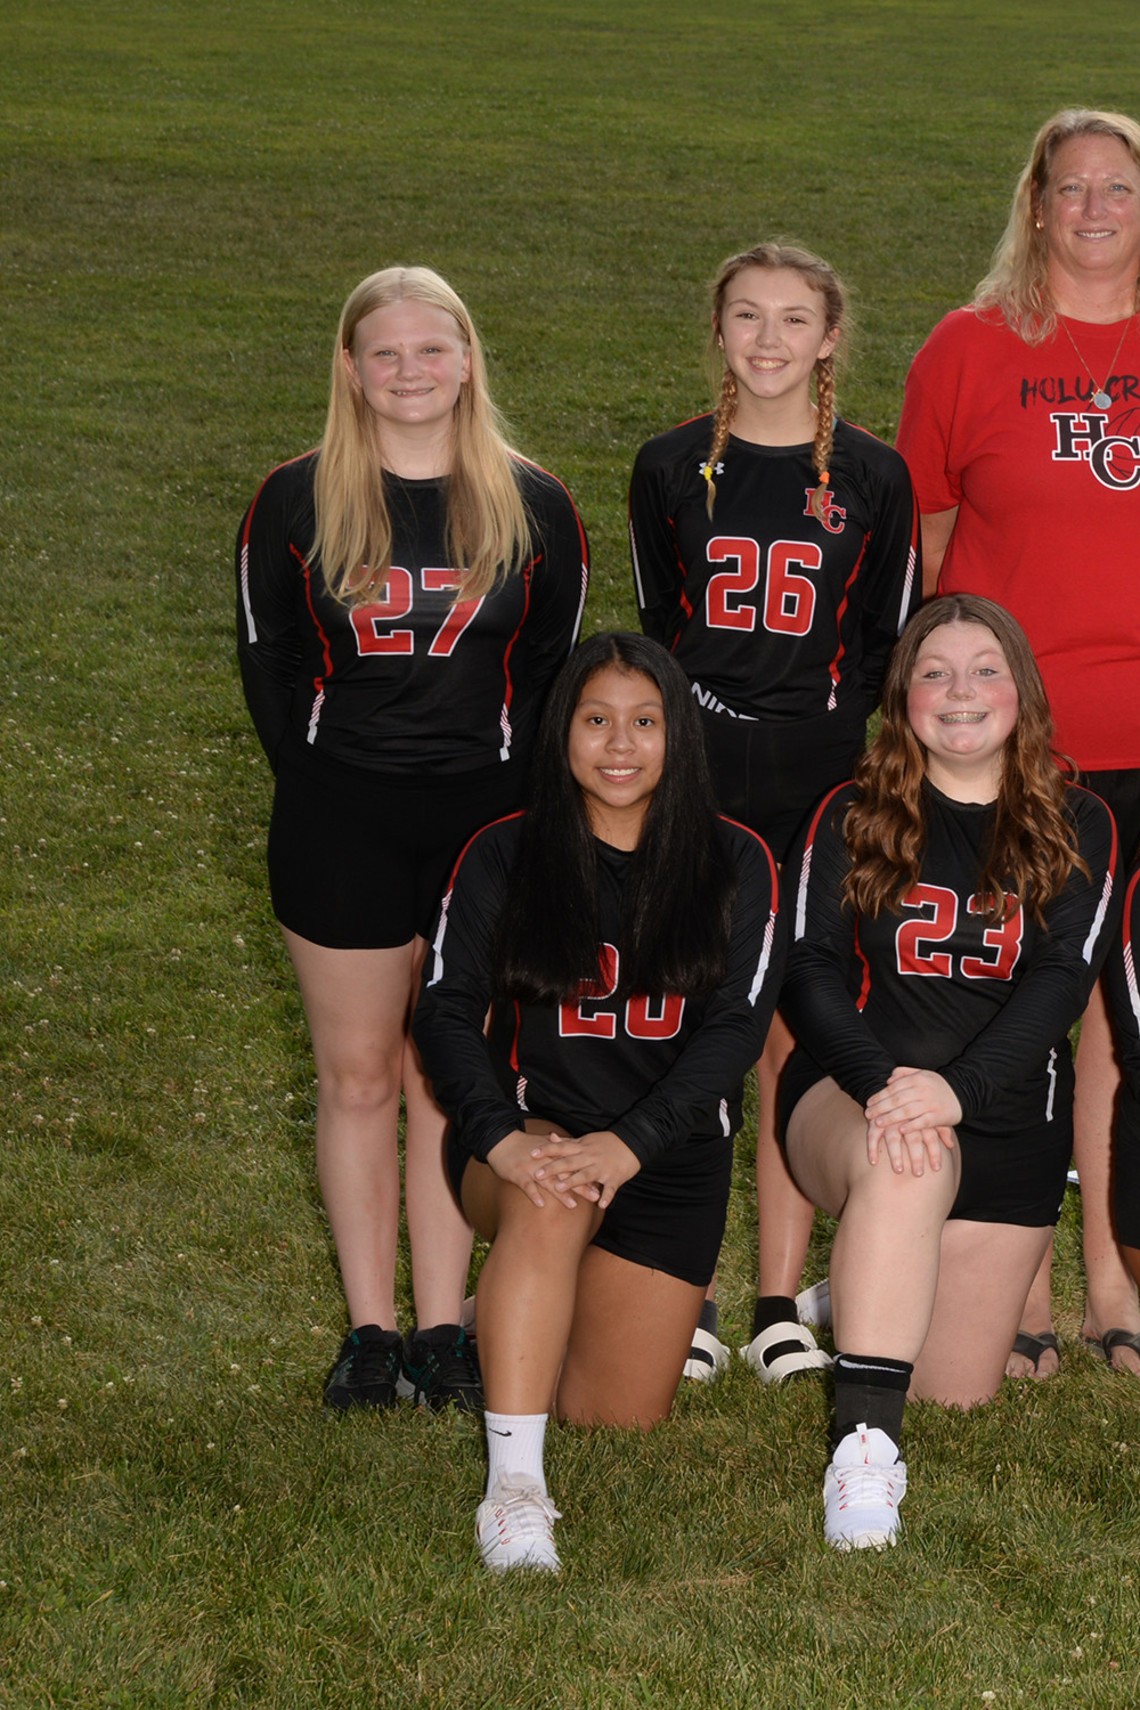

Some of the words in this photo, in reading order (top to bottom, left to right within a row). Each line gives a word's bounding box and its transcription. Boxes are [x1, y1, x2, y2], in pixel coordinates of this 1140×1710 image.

[348, 565, 486, 657] 27
[705, 536, 823, 636] 26
[895, 882, 1024, 981] 23
